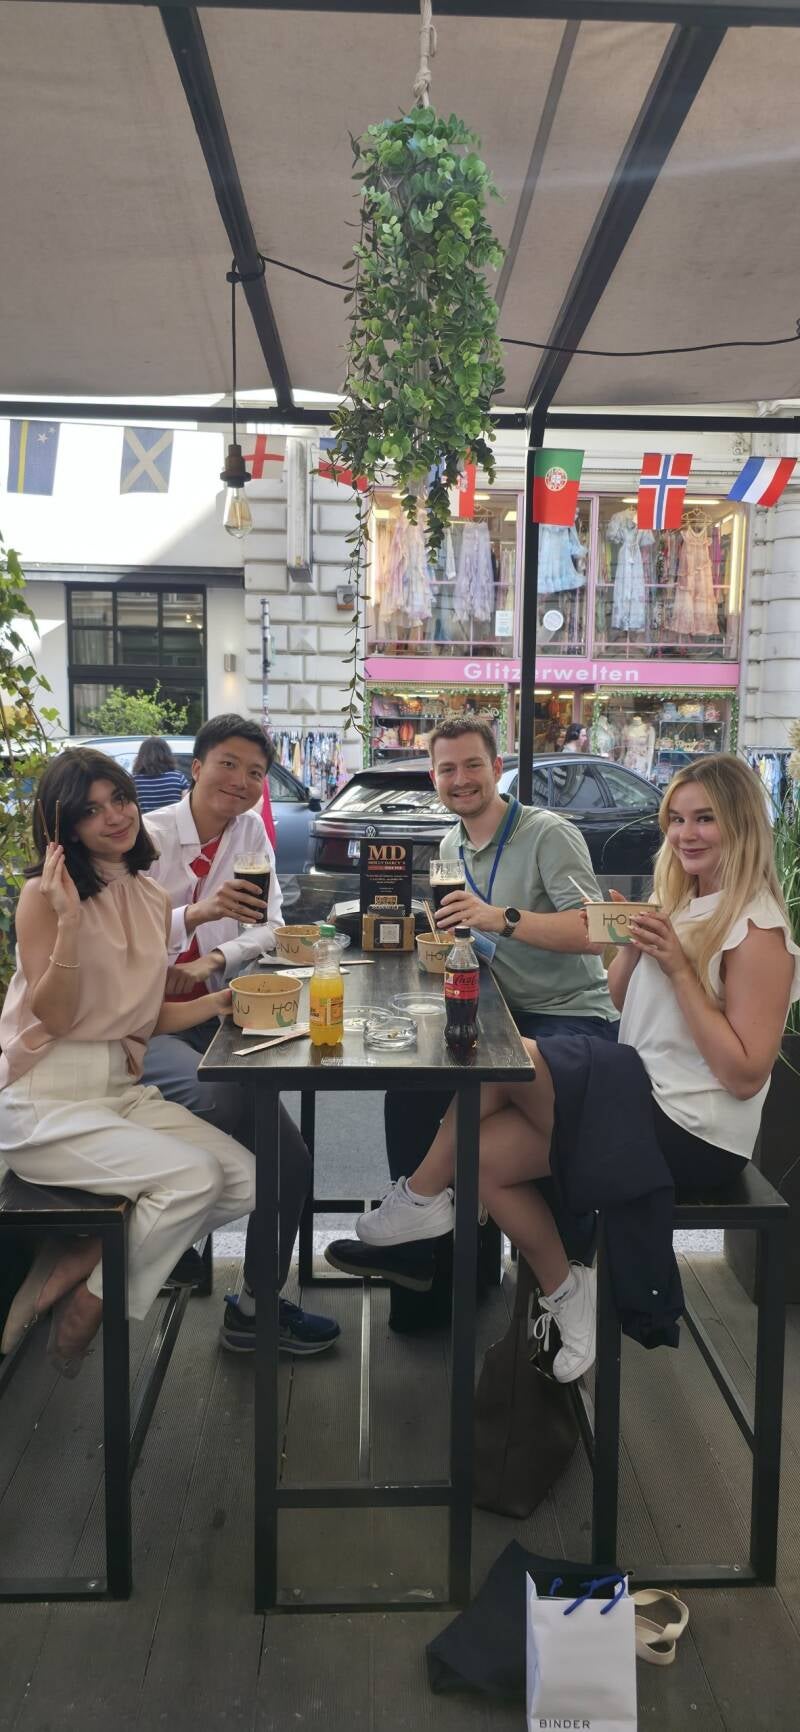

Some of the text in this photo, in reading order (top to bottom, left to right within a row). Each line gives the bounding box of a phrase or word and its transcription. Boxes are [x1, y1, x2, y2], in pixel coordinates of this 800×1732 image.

[463, 663, 639, 681] Glitzrwelten
[368, 845, 406, 861] MD
[540, 1719, 590, 1729] BINDER
